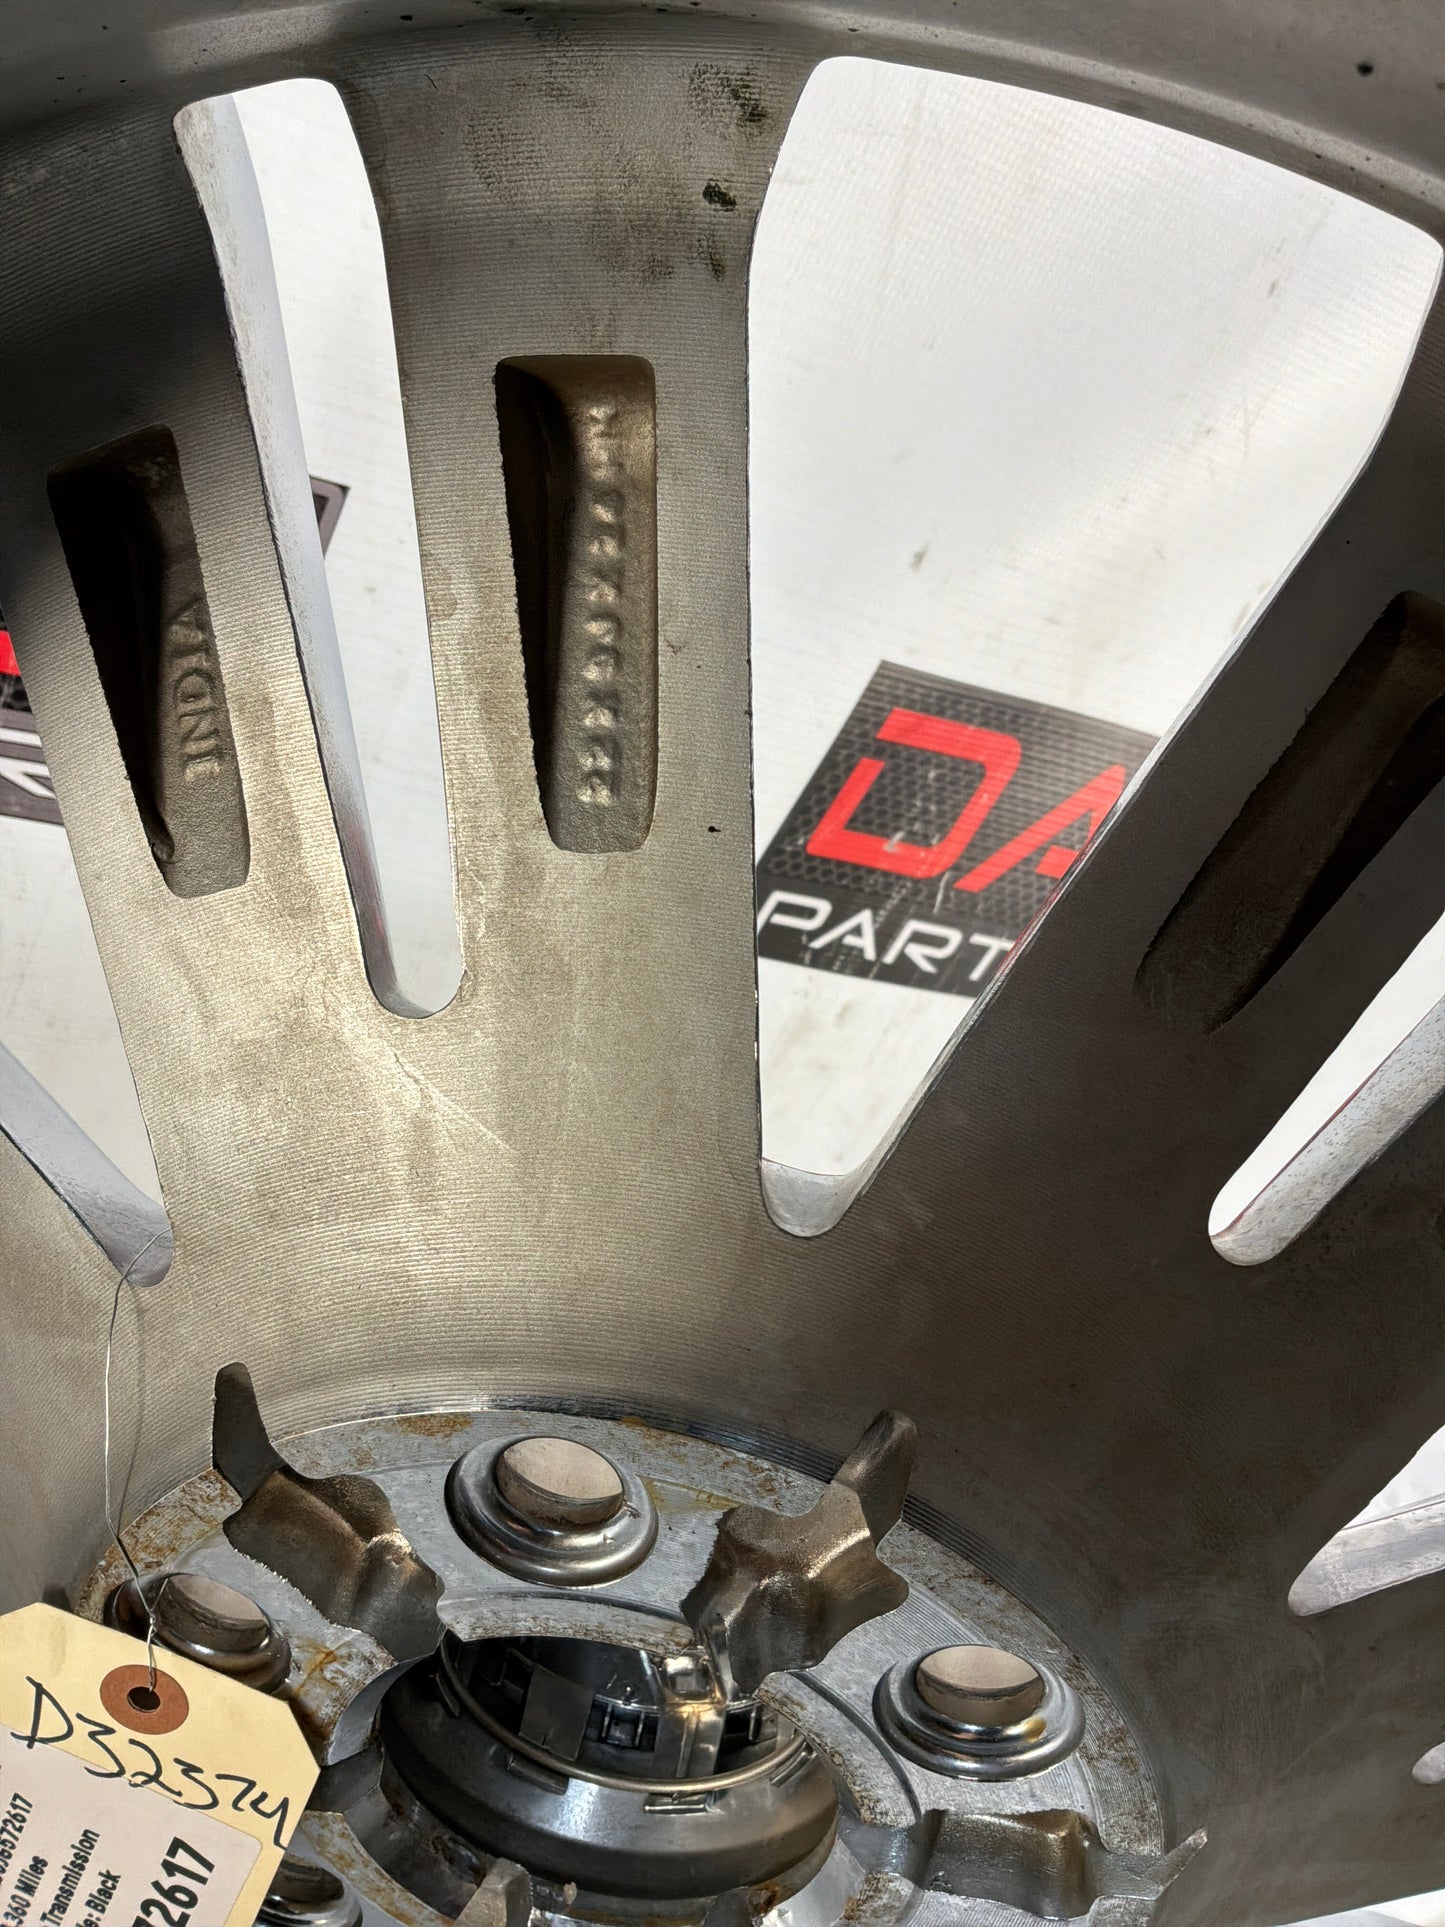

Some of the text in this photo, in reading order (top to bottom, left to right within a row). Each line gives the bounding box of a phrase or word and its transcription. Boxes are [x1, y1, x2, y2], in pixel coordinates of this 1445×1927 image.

[14, 1855, 49, 1898] Miles
[40, 1828, 101, 1927] Transmission
[84, 1868, 121, 1915] Black
